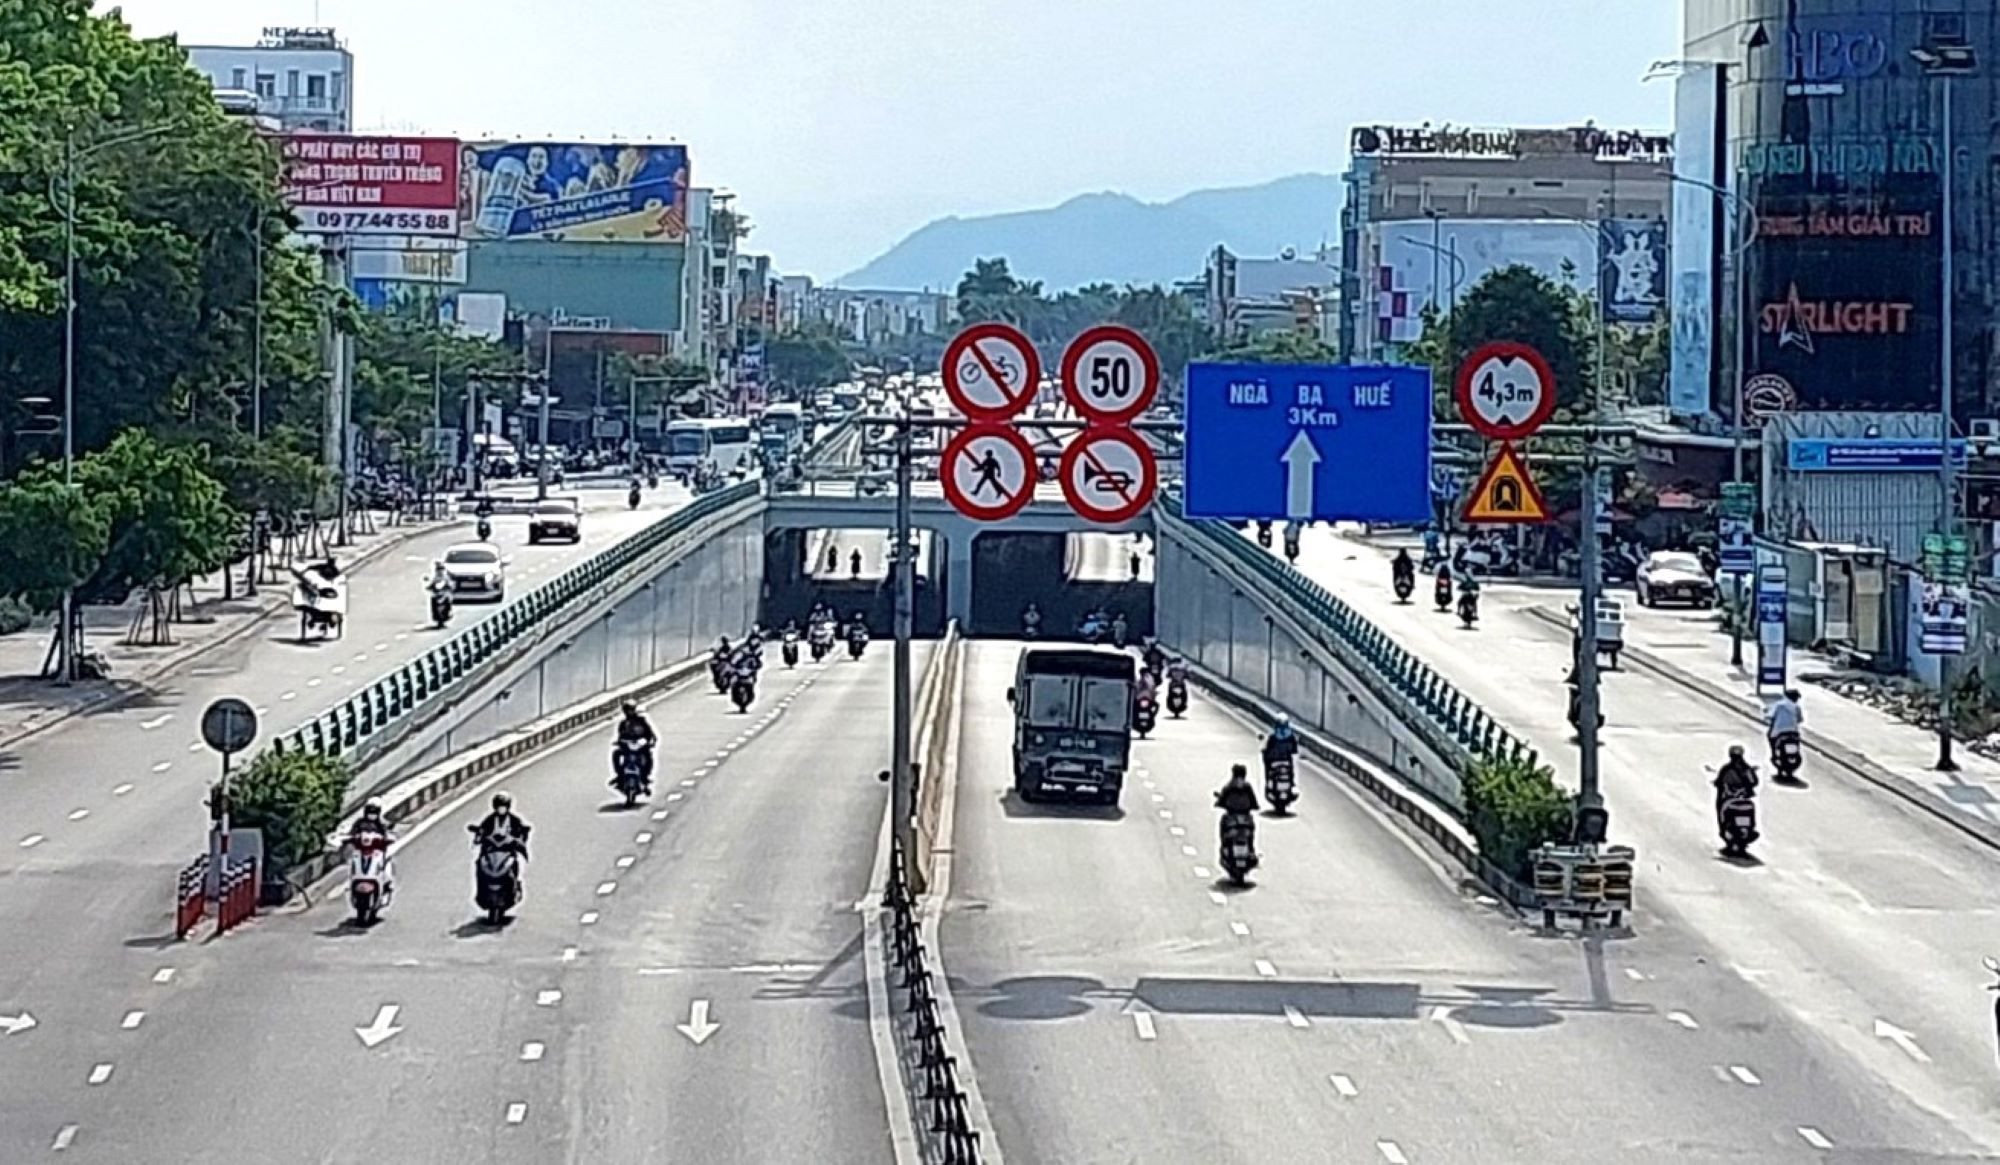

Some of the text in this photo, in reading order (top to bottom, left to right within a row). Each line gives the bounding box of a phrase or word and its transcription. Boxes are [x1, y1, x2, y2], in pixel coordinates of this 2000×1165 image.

[1895, 210, 1932, 236] TRÍ
[1761, 290, 1914, 340] STARLIGHT
[1091, 356, 1130, 398] 50
[1229, 378, 1393, 406] NGÃ BA HUẾ
[1479, 371, 1534, 408] 4,3m
[1288, 406, 1338, 426] 3Km
